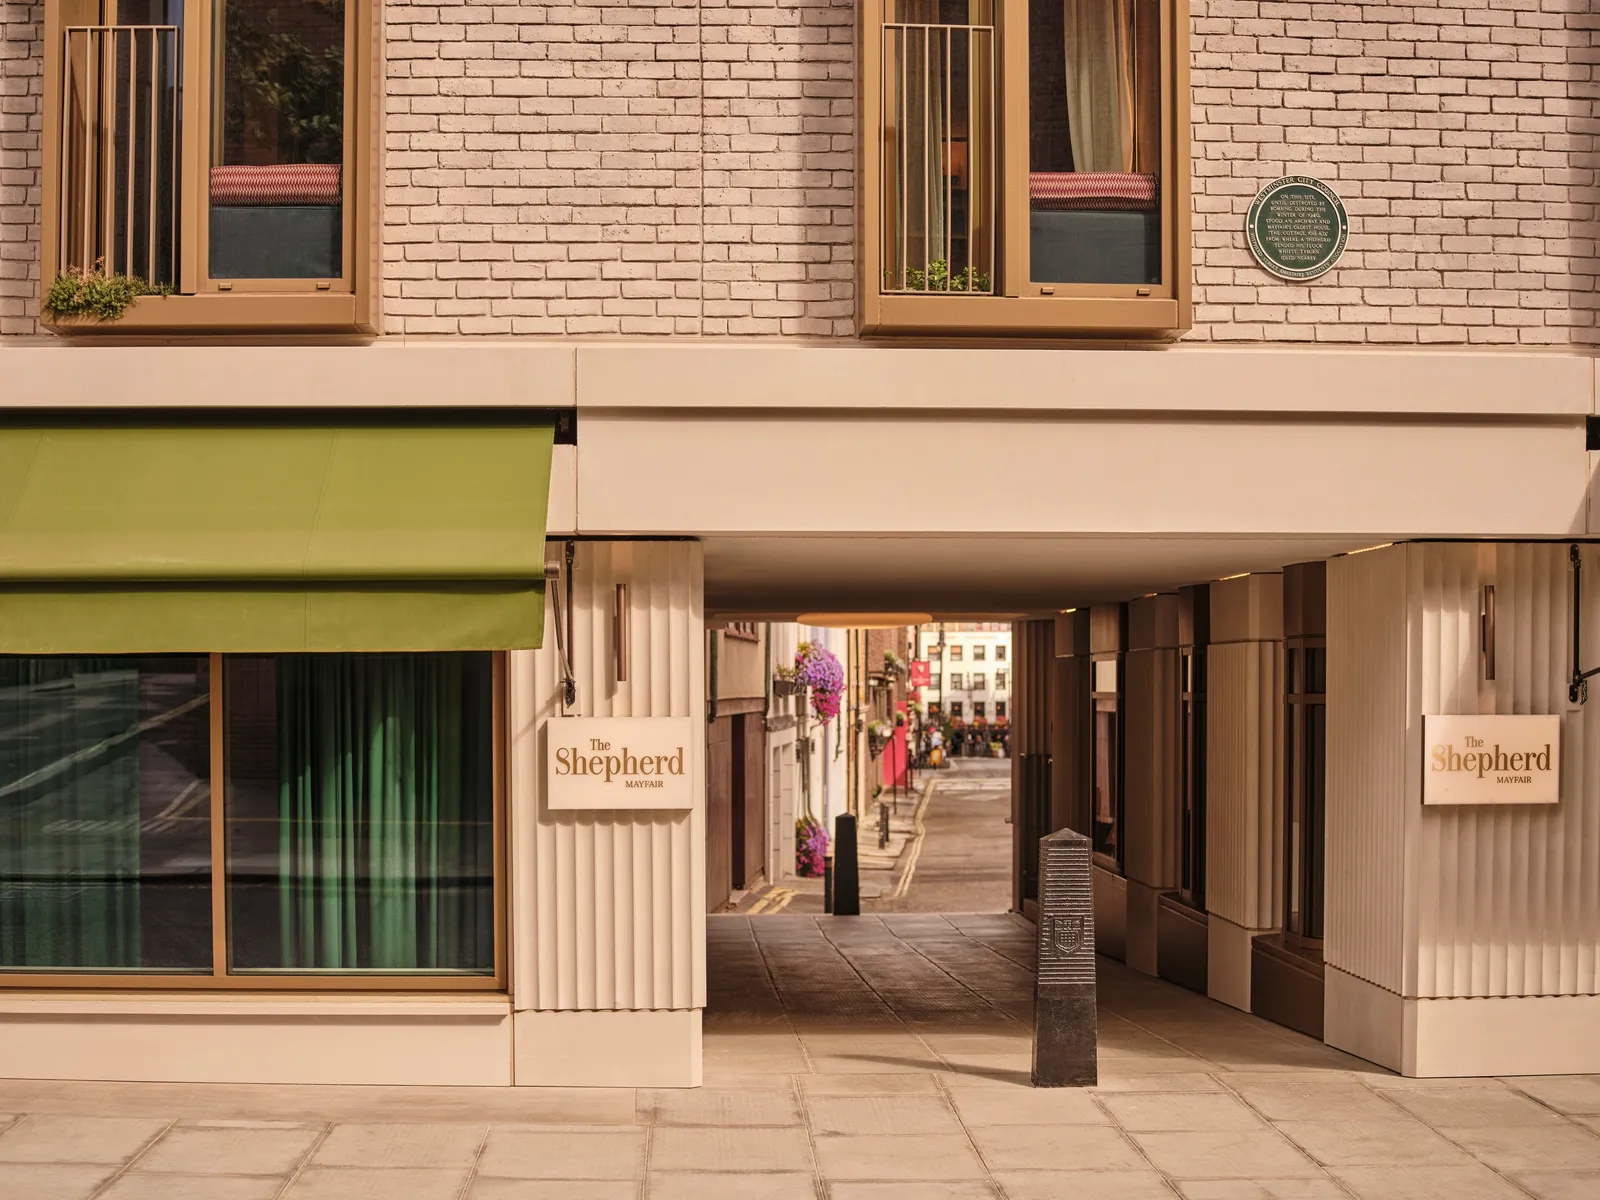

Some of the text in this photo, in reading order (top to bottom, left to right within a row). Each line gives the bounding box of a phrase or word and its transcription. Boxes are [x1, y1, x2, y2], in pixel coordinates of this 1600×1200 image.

[1254, 176, 1340, 207] WESTMINSTER CITY COUNCIL
[1263, 257, 1279, 271] STREET
[1330, 233, 1346, 264] ASSOCIATION
[590, 738, 611, 751] The
[1464, 736, 1484, 748] The
[555, 747, 685, 782] Shepherd
[1431, 744, 1552, 779] Shepherd
[625, 780, 664, 788] MAYFAIR
[1496, 776, 1532, 784] MAYFAIR
